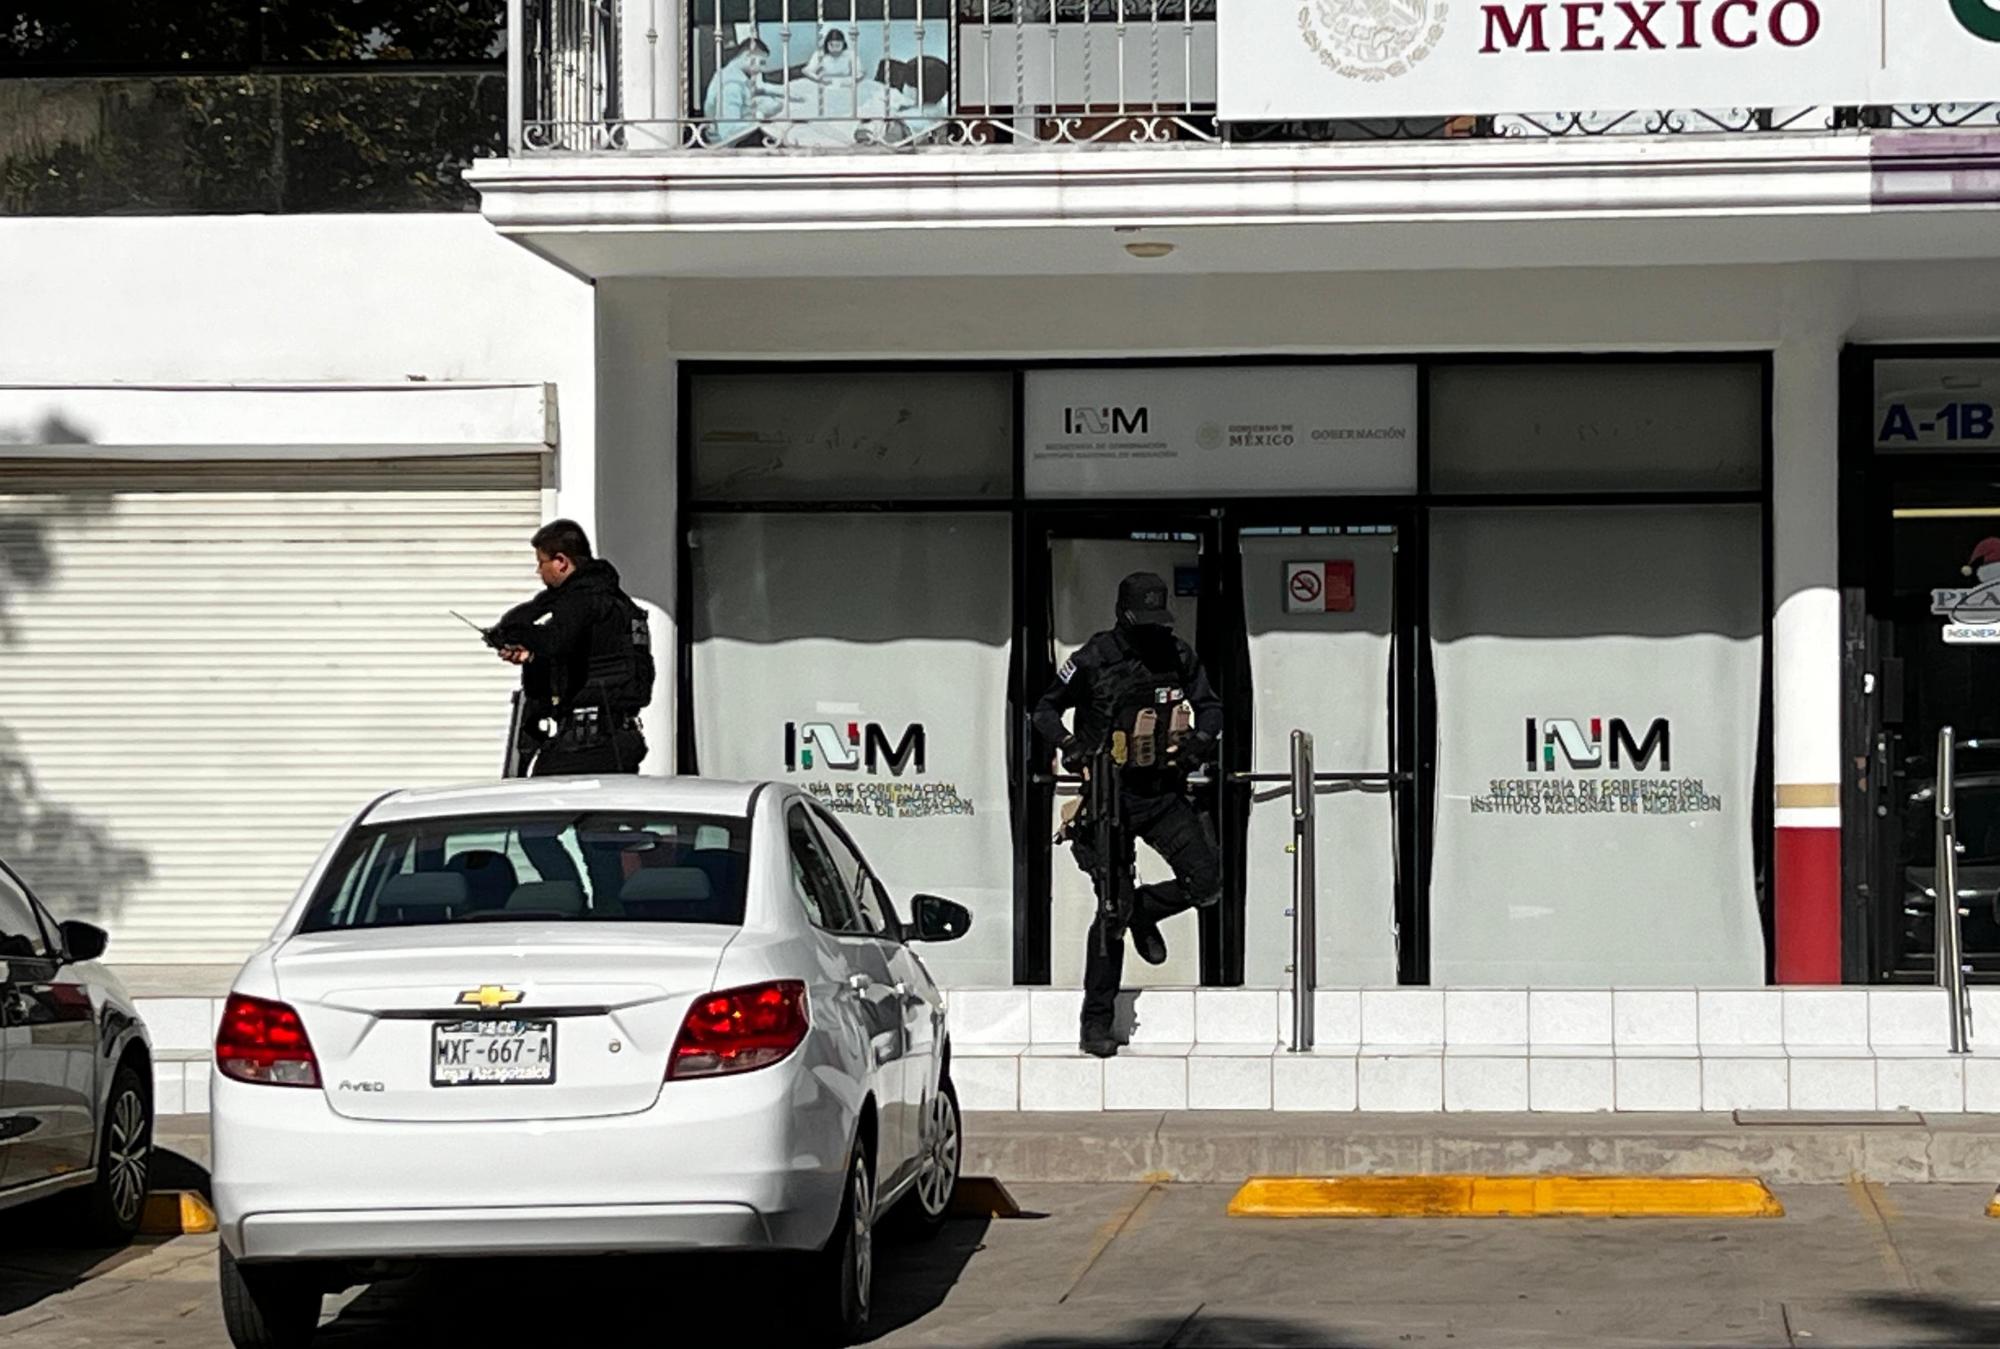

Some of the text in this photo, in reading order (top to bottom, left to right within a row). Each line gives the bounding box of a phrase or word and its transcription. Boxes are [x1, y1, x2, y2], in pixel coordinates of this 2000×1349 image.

[1228, 432, 1295, 447] MÉXICO
[1311, 427, 1406, 441] GOBERNACIÓN
[1878, 402, 1994, 442] A-1B
[785, 721, 926, 776] INM
[1526, 717, 1670, 771] INM
